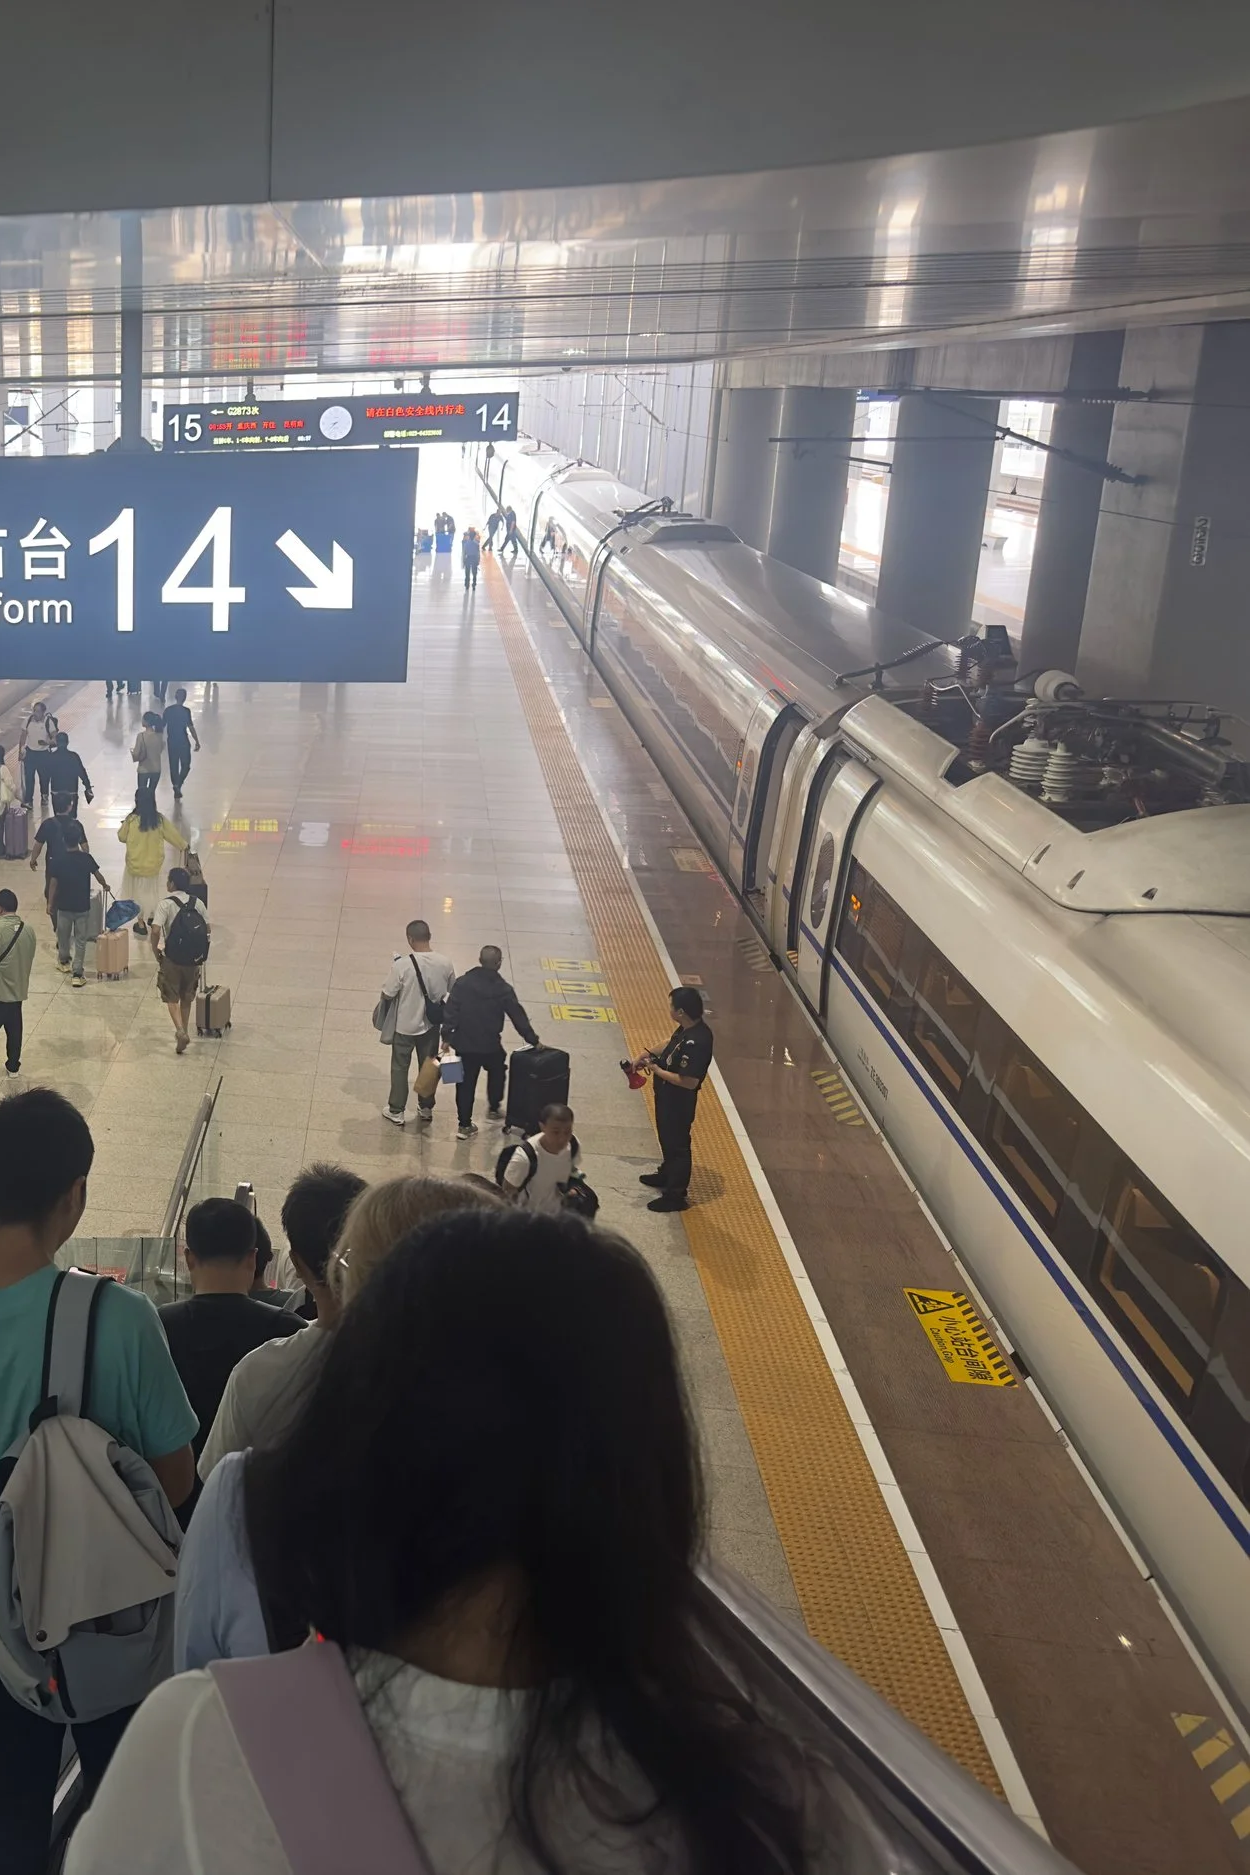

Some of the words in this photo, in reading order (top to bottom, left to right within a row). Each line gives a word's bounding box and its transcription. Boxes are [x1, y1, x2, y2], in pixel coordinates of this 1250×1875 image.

[365, 403, 466, 419] 请在白色安全线内行走
[475, 402, 512, 432] 14
[168, 413, 203, 442] 15
[88, 506, 246, 632] 14
[938, 1315, 994, 1381] 小心站台间隙
